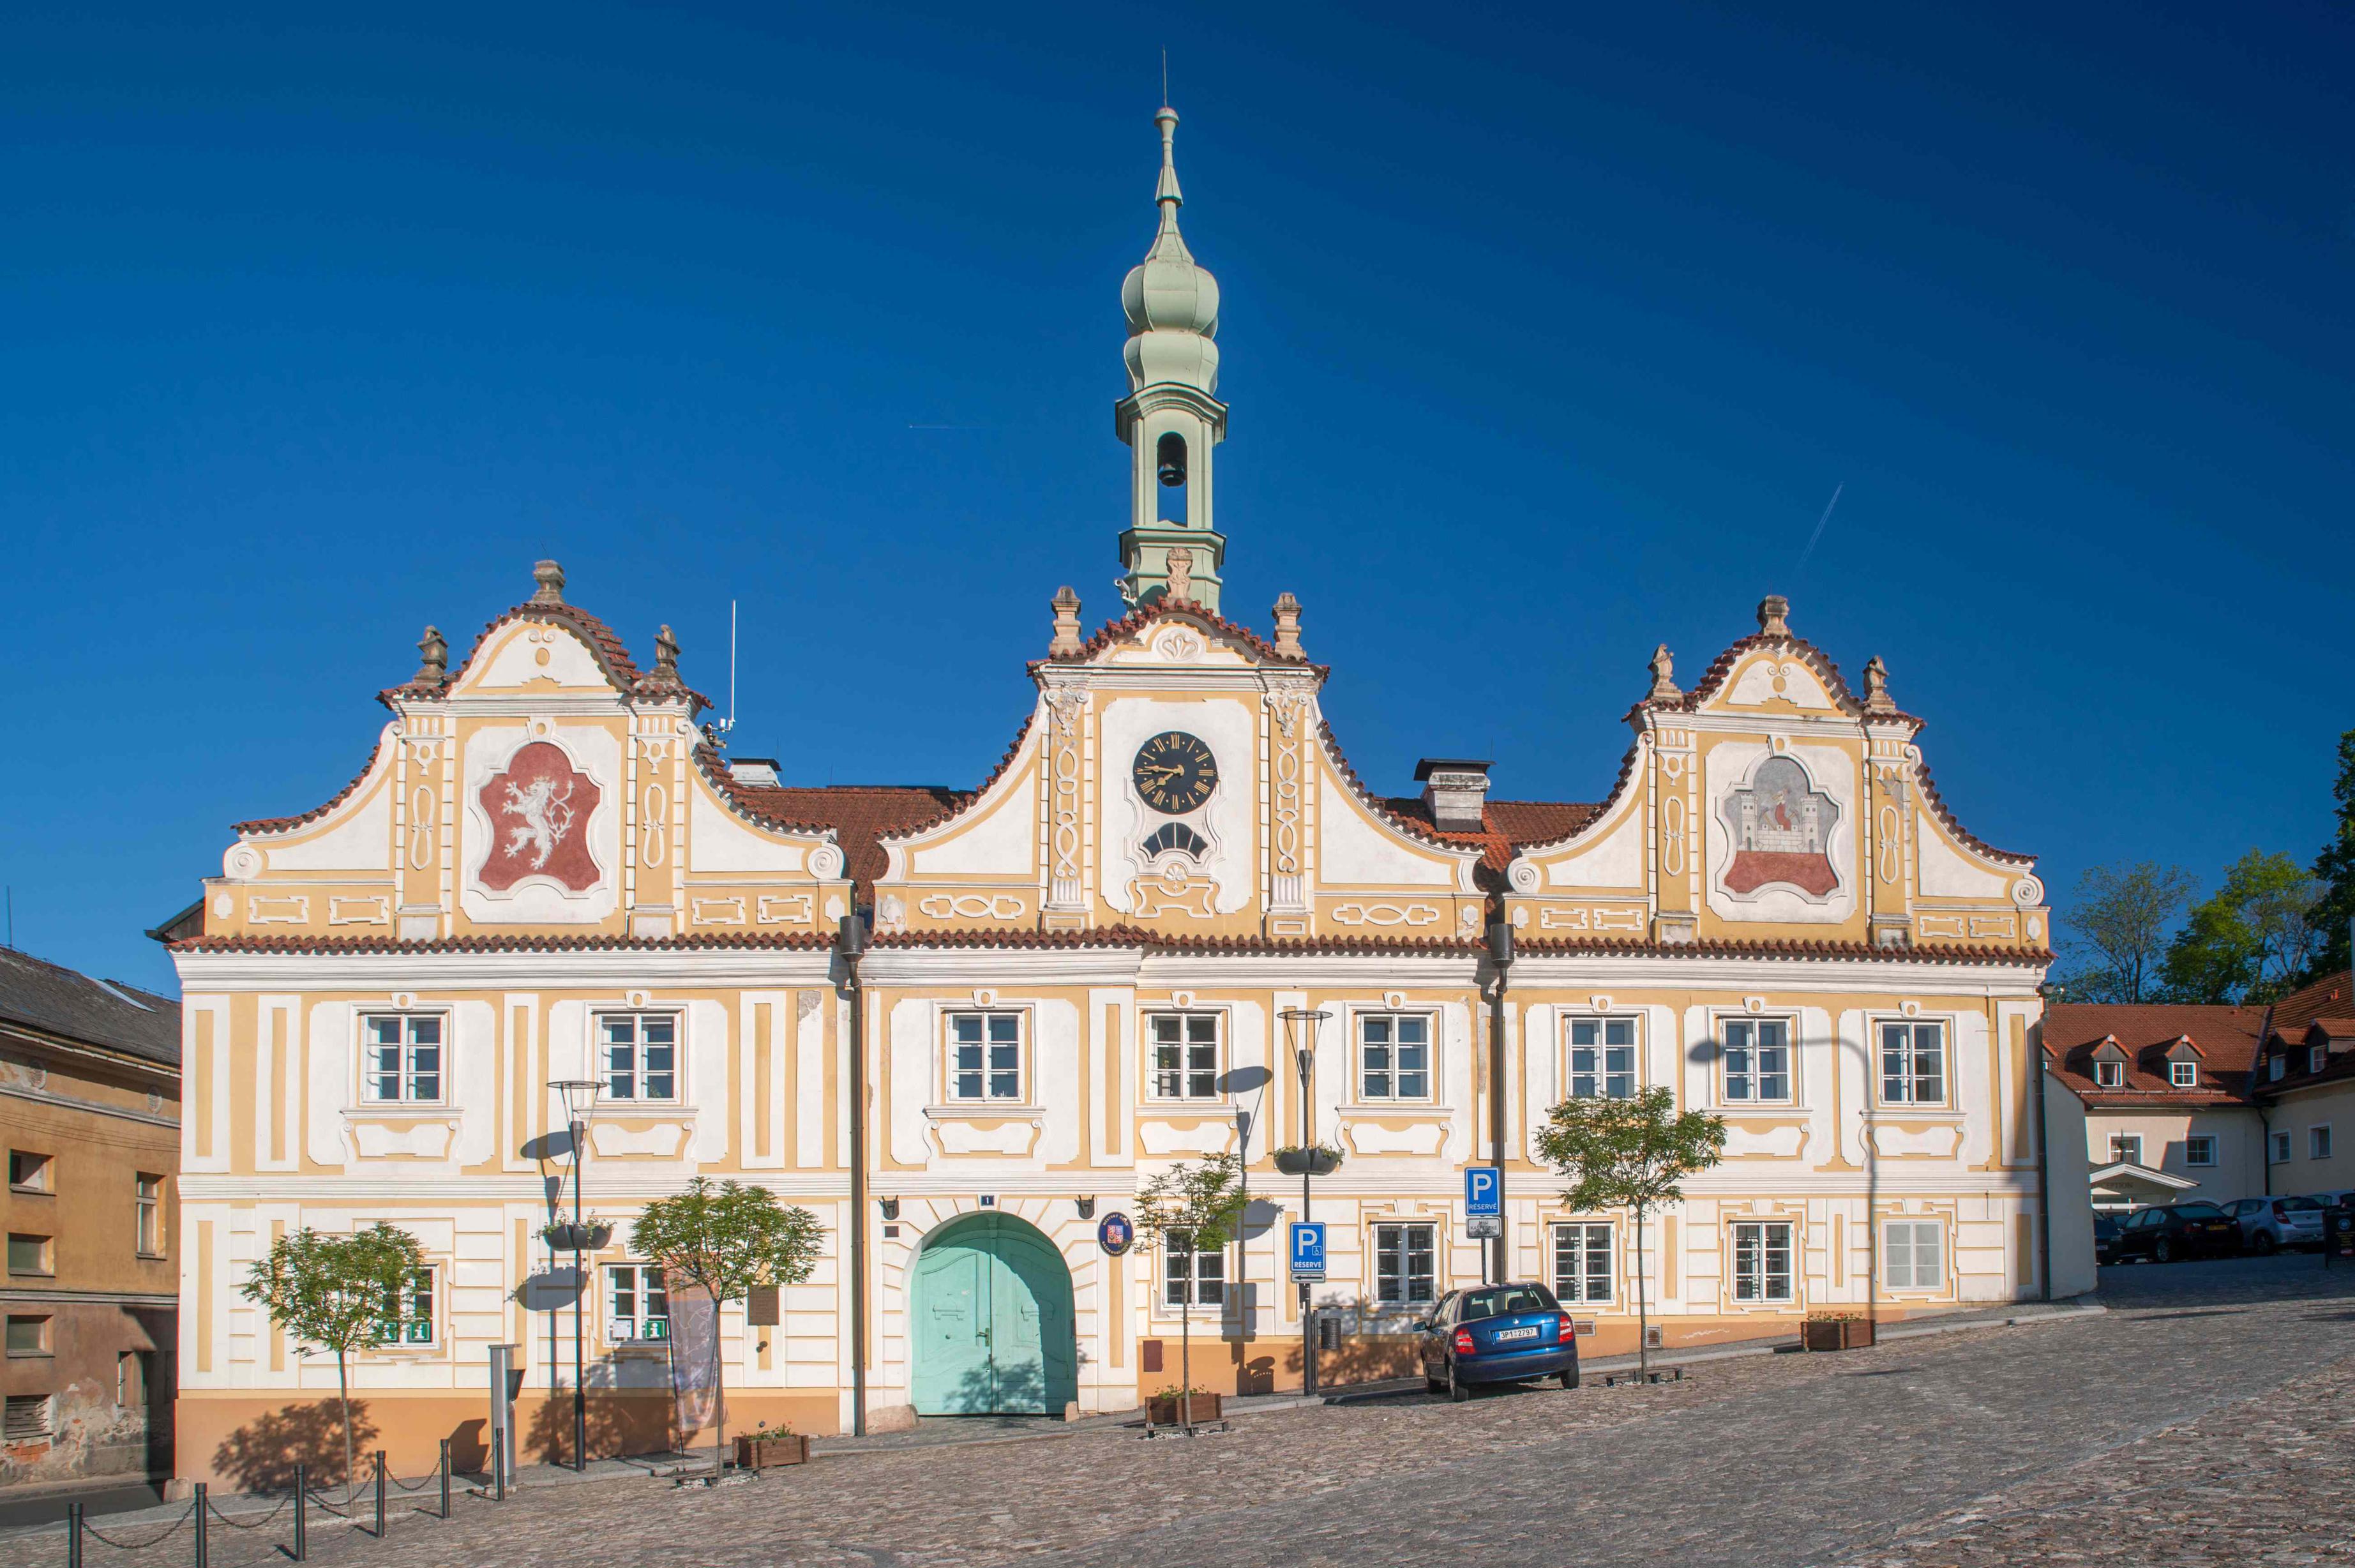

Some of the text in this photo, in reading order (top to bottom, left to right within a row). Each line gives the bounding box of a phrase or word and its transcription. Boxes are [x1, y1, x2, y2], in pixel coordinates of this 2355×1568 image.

[1171, 734, 1179, 750] XII
[1195, 752, 1210, 763] II
[1473, 1173, 1492, 1201] P
[1298, 1228, 1318, 1256] P
[1294, 1260, 1322, 1268] RÉSERVÉ
[1518, 1328, 1533, 1336] 2797
